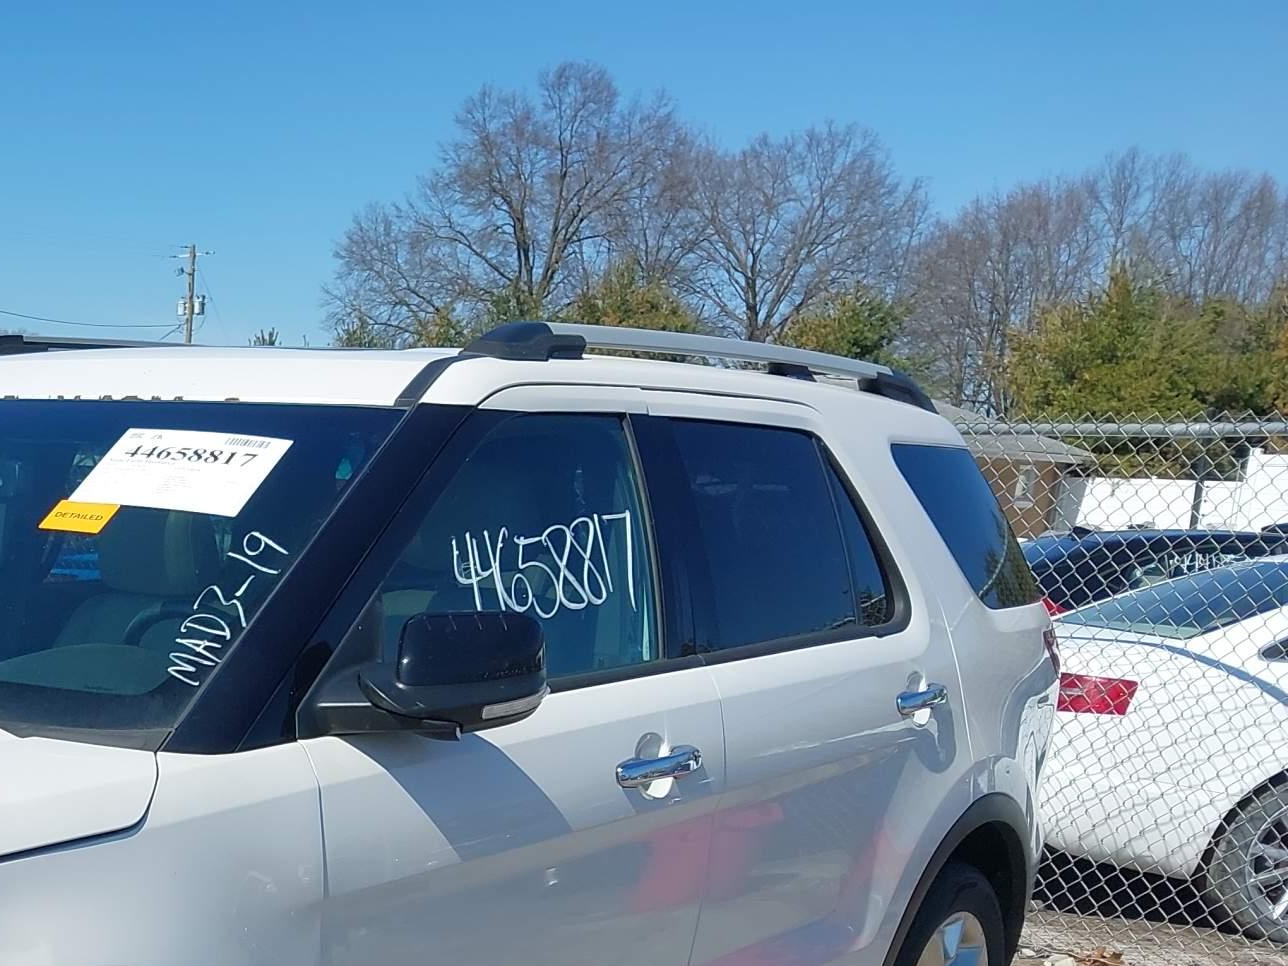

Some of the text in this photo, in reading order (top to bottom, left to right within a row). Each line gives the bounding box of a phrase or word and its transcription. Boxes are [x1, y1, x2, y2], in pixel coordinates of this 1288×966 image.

[124, 444, 260, 468] 44658817
[54, 511, 104, 521] DETAILED
[450, 509, 638, 619] 44658817
